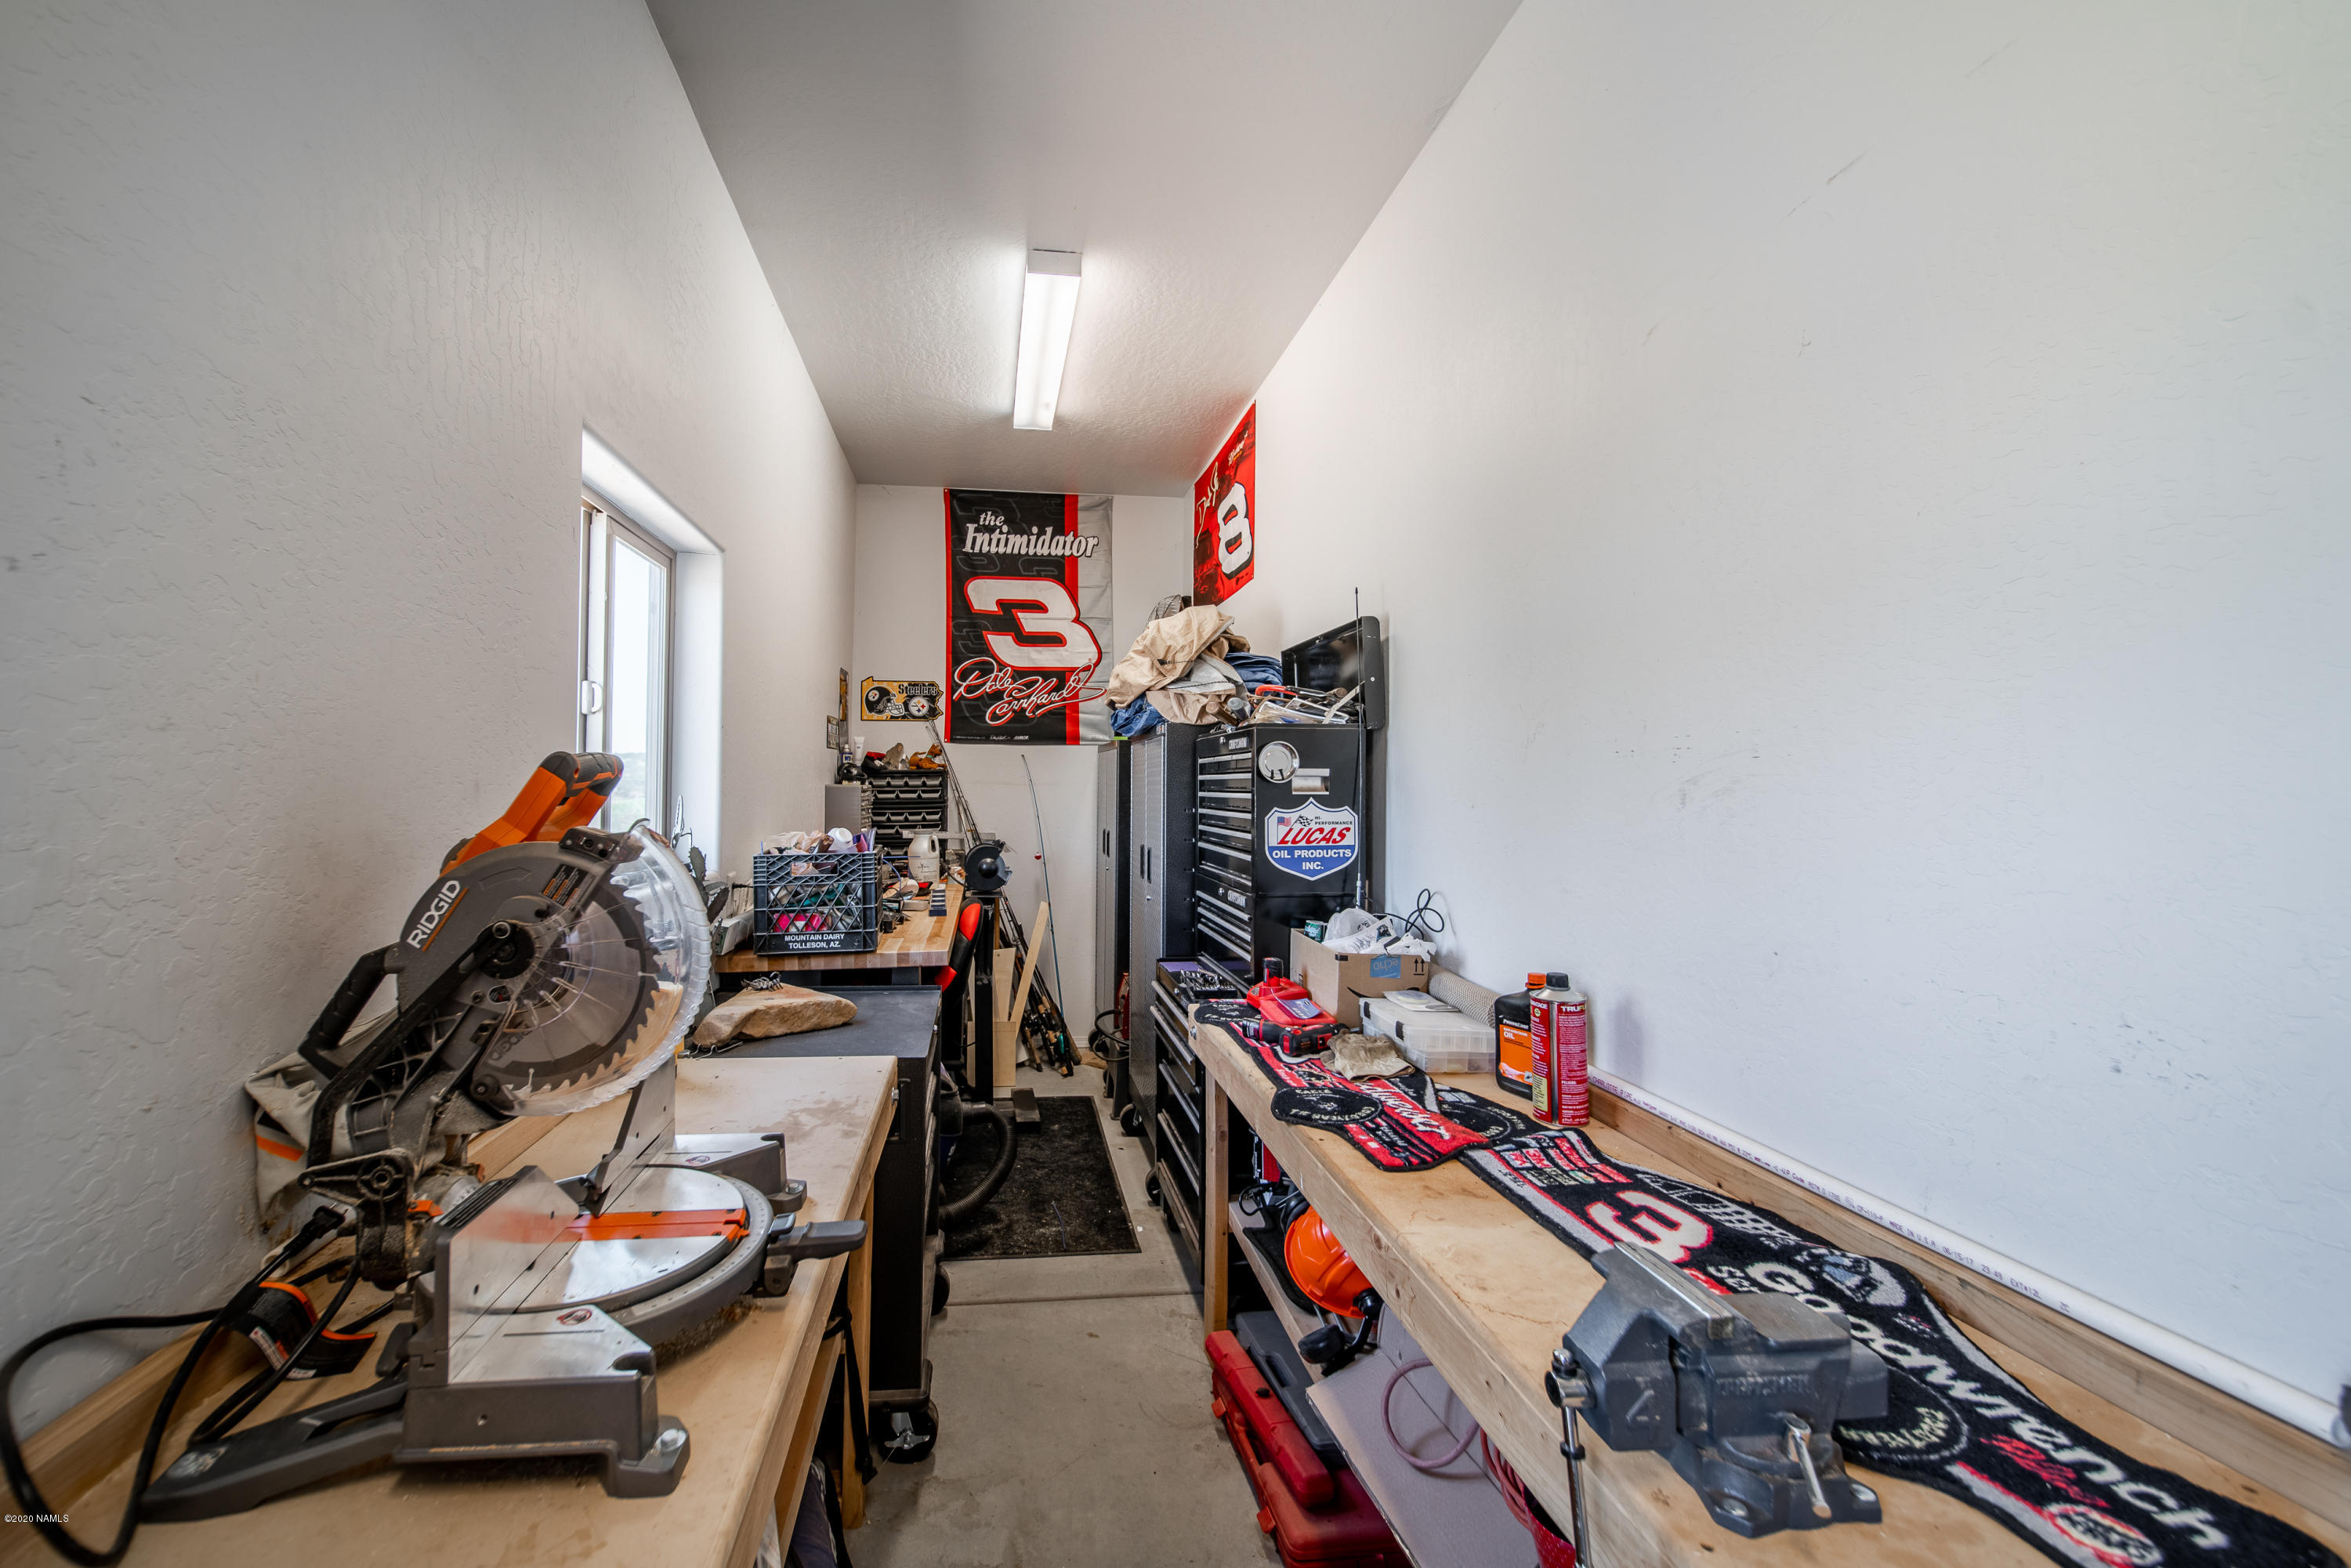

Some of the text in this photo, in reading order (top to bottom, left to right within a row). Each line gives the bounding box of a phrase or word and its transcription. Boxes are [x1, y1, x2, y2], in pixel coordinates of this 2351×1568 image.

[980, 511, 1005, 527] the
[1217, 481, 1253, 580] 8
[962, 523, 1099, 558] Intimidator
[964, 576, 1103, 672] 3
[898, 683, 938, 696] Steelers
[953, 657, 1013, 701] Dale
[1277, 827, 1351, 845] LUCAS
[1272, 849, 1352, 859] OIL PRODUCTS
[1302, 861, 1324, 870] INC.
[408, 879, 462, 951] RIDGID
[1503, 1031, 1516, 1040] OIL
[1585, 1190, 1715, 1263] 3
